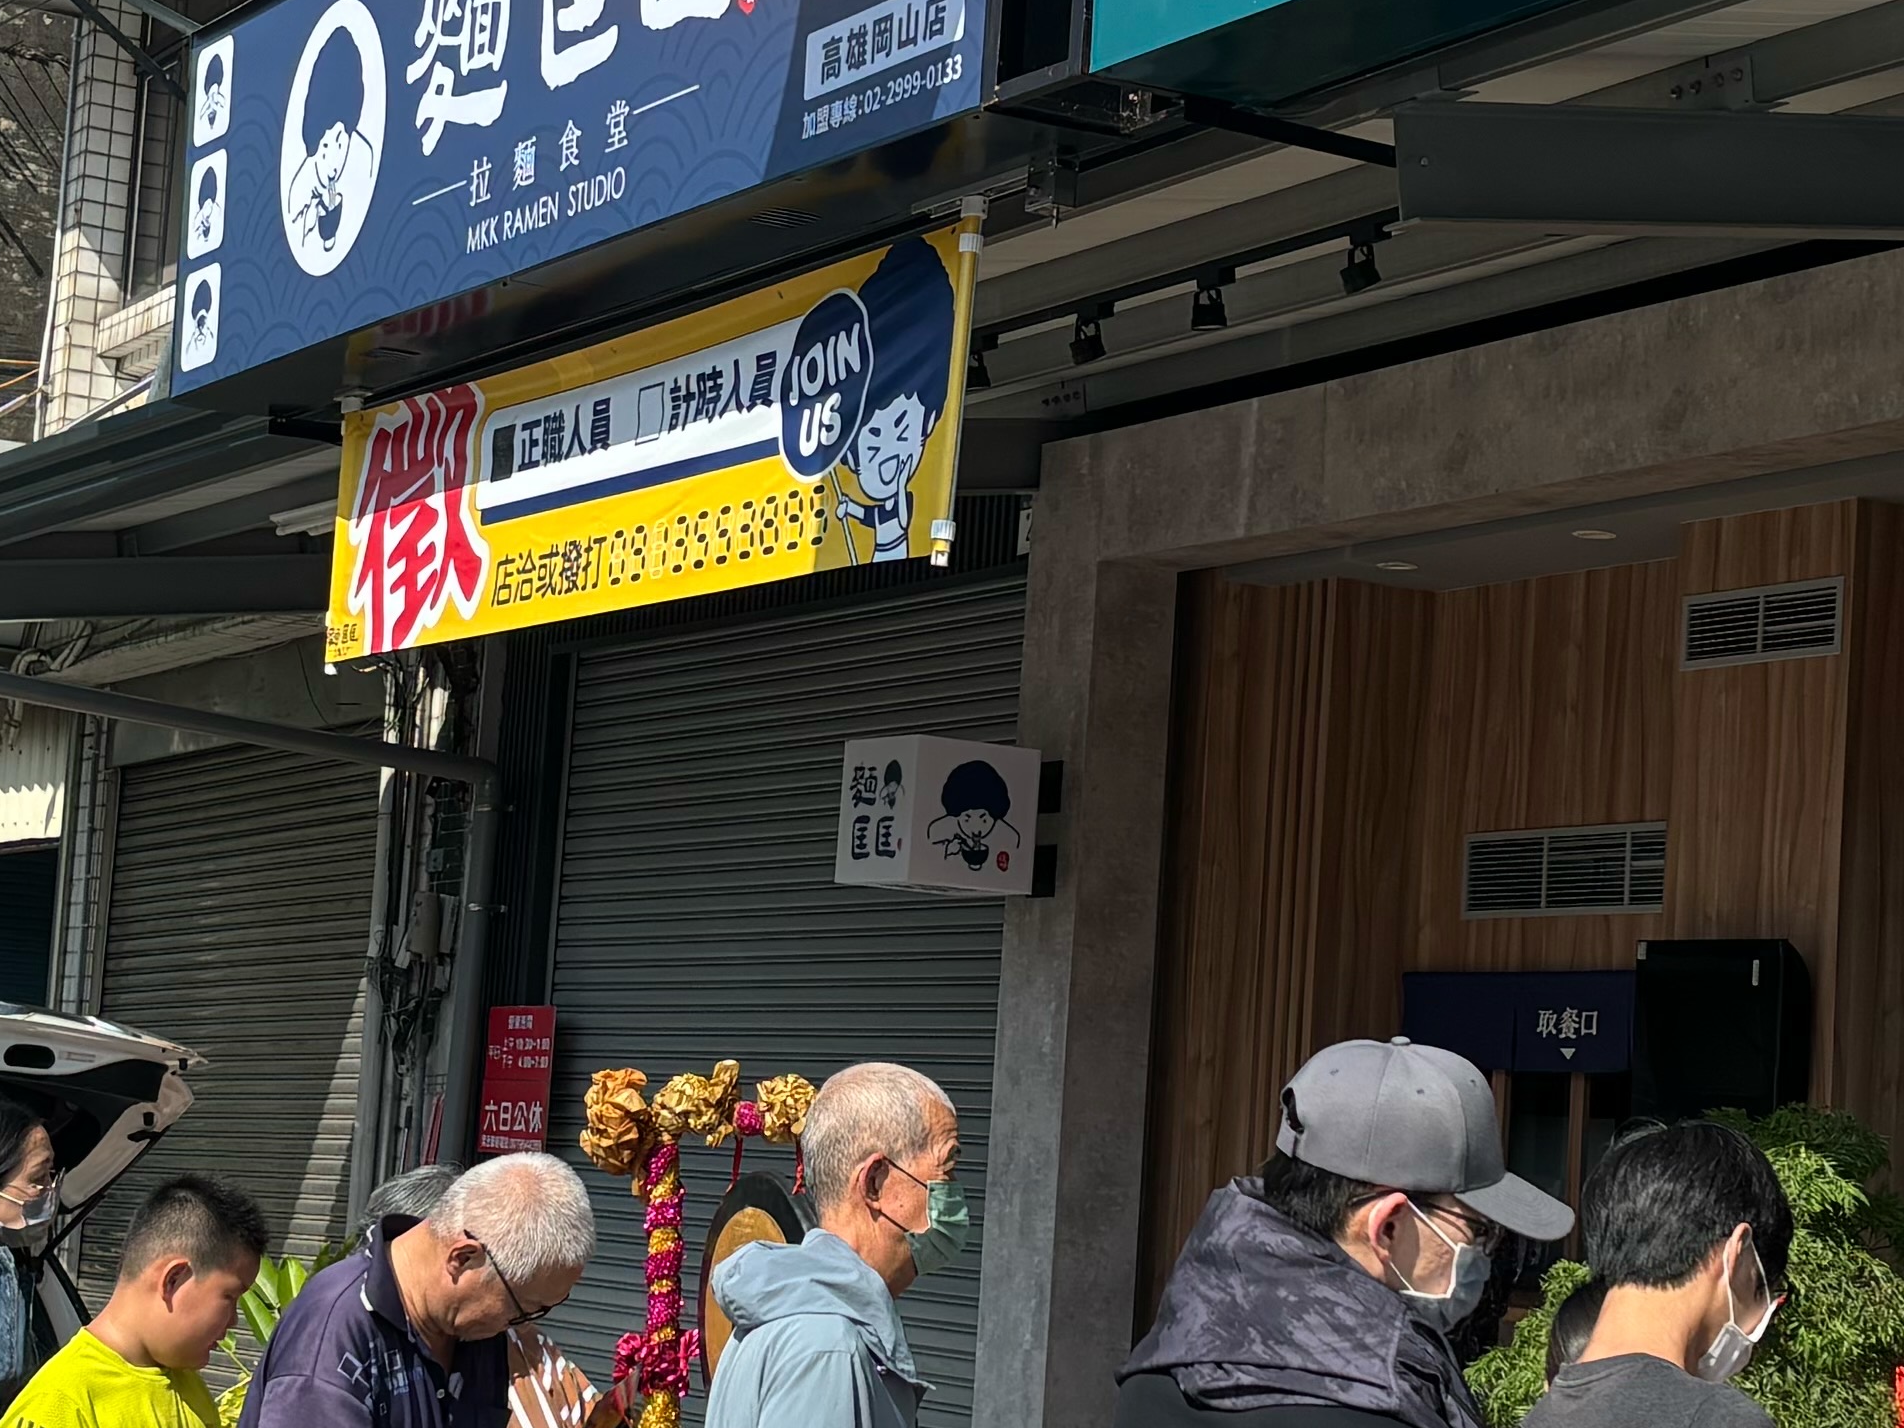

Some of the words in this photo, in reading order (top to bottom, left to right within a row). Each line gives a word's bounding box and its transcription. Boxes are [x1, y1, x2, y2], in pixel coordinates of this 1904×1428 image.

[468, 99, 629, 207] 拉麵食堂
[465, 214, 499, 255] MKK
[503, 191, 561, 244] RAMEN
[566, 166, 628, 226] STUDIO
[790, 322, 862, 406] JOIN
[517, 397, 612, 471] 正職人員
[669, 351, 778, 434] 計時人員
[800, 393, 841, 456] US
[354, 383, 484, 655] 徵
[849, 766, 879, 808] 麵
[851, 816, 896, 861] 匡匡
[1536, 1005, 1599, 1038] 取餐口
[484, 1100, 543, 1132] 六日公休
